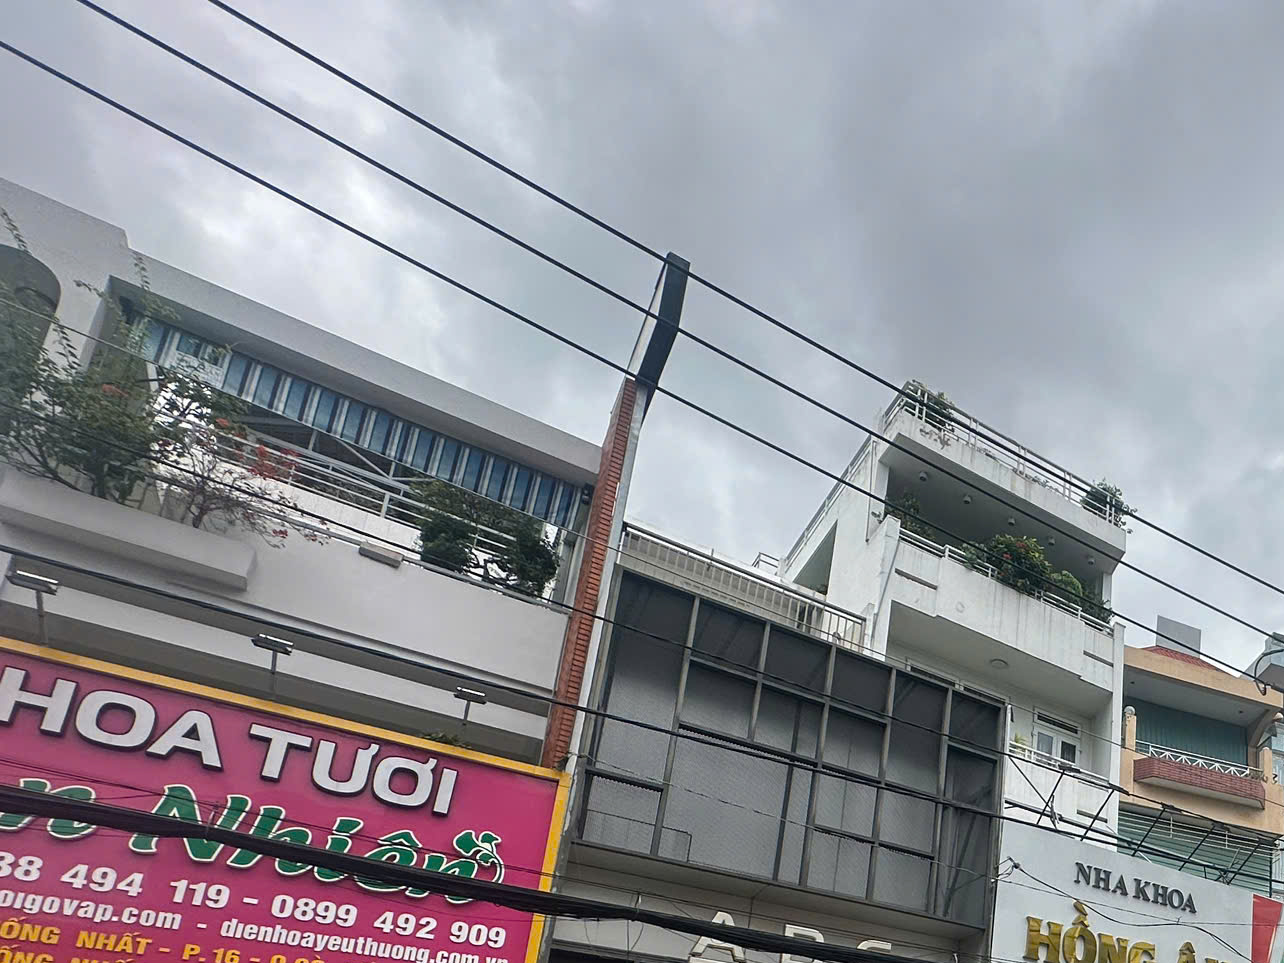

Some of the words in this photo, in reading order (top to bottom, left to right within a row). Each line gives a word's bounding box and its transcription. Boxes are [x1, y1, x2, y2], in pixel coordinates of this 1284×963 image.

[0, 666, 224, 772] HOA
[248, 723, 459, 817] TƯƠI
[60, 864, 144, 897] 494
[170, 879, 230, 909] 119
[271, 894, 358, 928] 0899
[373, 911, 438, 940] 492
[450, 921, 507, 949] 909
[1073, 861, 1128, 897] NHA
[1132, 877, 1197, 914] KHOA
[76, 931, 152, 955] NHẤT
